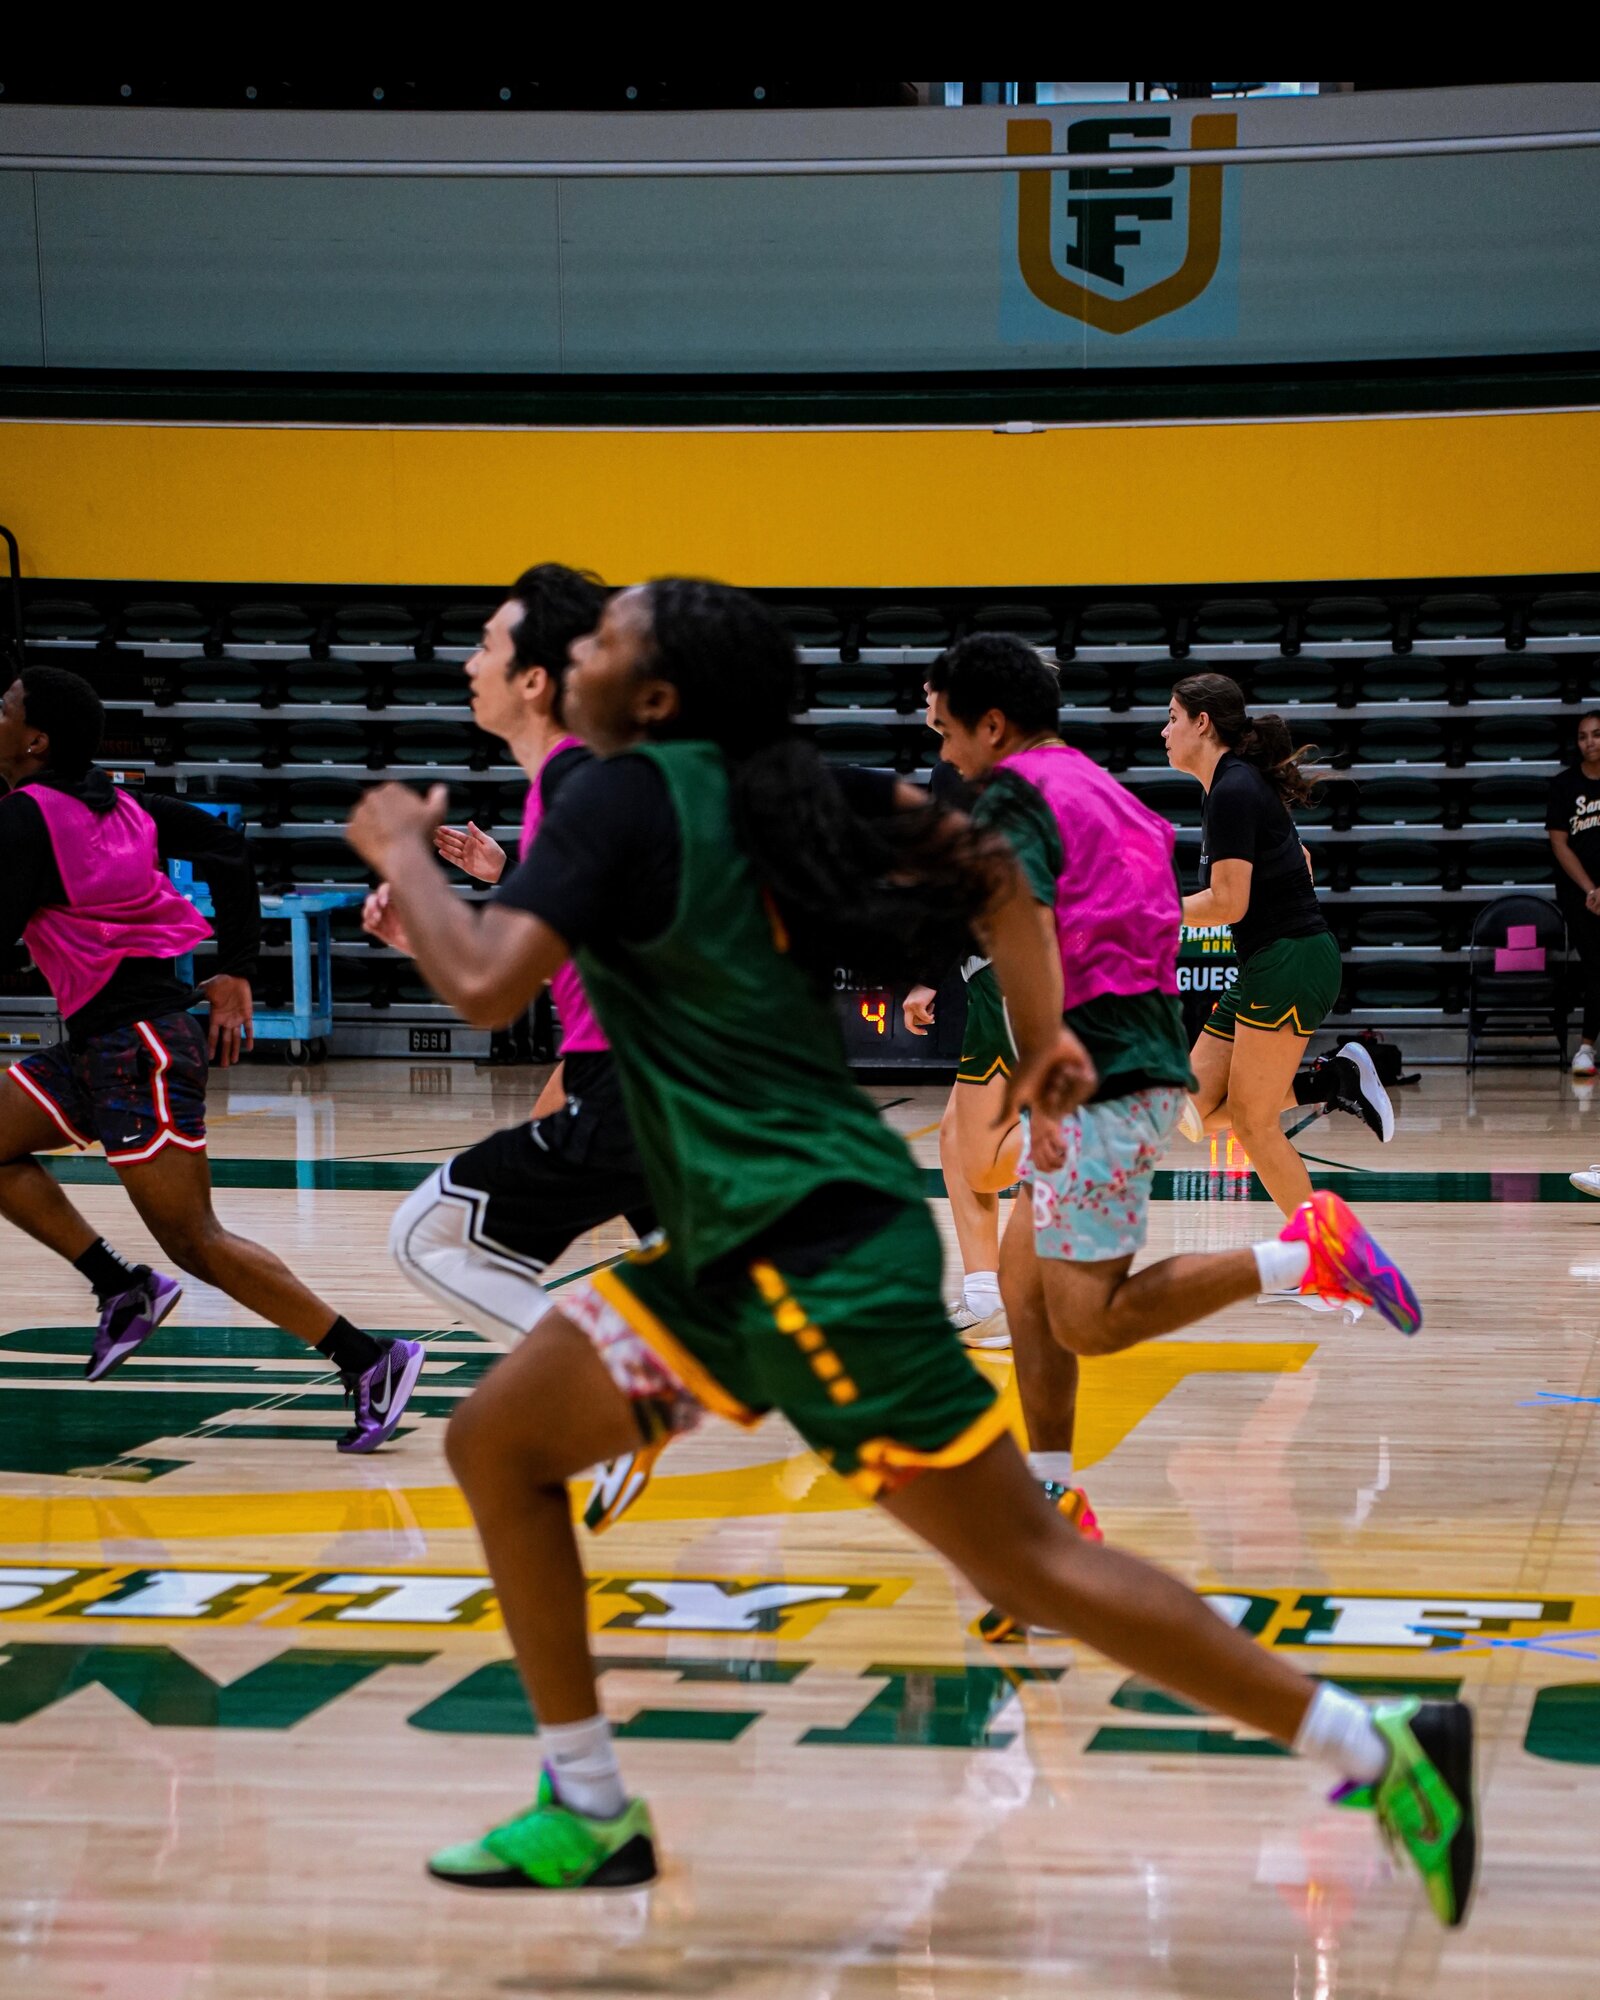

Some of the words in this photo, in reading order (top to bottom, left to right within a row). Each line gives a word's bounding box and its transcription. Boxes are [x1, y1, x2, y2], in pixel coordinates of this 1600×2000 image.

[1575, 794, 1600, 816] San
[1202, 940, 1236, 953] DON
[861, 1002, 886, 1035] 4
